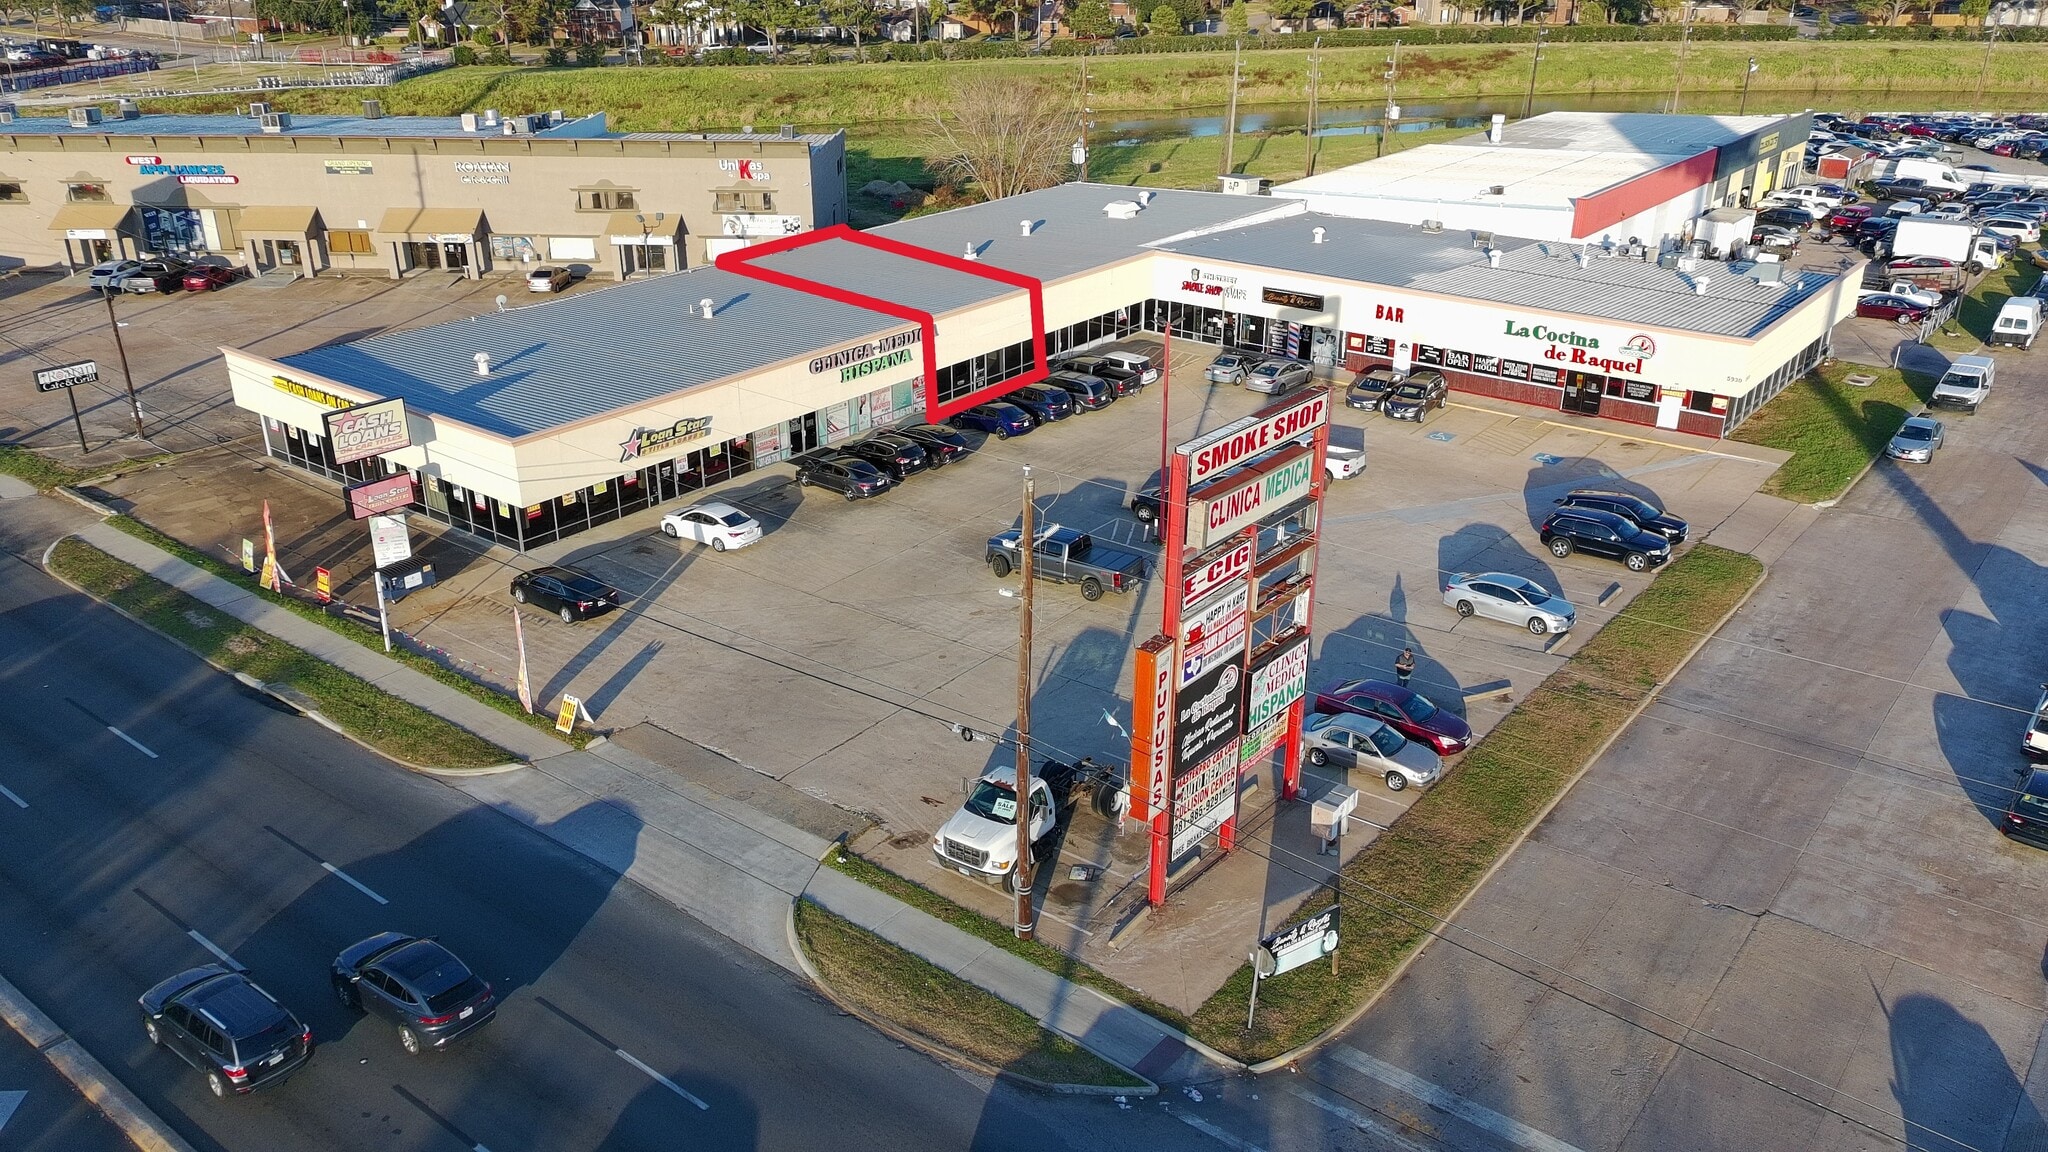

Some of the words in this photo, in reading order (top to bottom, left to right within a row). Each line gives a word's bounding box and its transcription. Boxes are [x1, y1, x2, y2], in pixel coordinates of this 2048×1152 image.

[128, 156, 157, 165] WEST
[140, 165, 226, 175] APPLIANCES
[454, 161, 511, 173] ROATAN
[180, 175, 235, 184] LIQUIDATION
[752, 172, 771, 181] spa
[1205, 284, 1223, 296] SHOP
[1375, 304, 1404, 323] BAR
[1504, 320, 1530, 338] La
[1532, 325, 1600, 349] Cocina
[840, 348, 913, 383] HISPANA
[1447, 352, 1469, 362] BAR
[1447, 358, 1470, 367] OPEN
[1475, 363, 1498, 373] HOUR
[1544, 344, 1567, 361] de
[1569, 347, 1643, 374] Raquel
[74, 373, 97, 384] Grill
[288, 381, 305, 396] CASH
[306, 386, 326, 404] LOANS
[337, 421, 401, 449] LOANS
[341, 410, 394, 434] CASH
[640, 428, 674, 448] Loan
[674, 419, 707, 437] Star
[1197, 423, 1269, 476] SMOKE
[1273, 400, 1323, 440] SHOP
[368, 493, 388, 504] Loan
[388, 486, 409, 497] Star
[1210, 482, 1260, 529] CLINICA
[1264, 458, 1310, 502] MEDICA
[1184, 546, 1249, 598] E-CIG
[1206, 602, 1225, 626] HAPPY
[1226, 600, 1232, 610] H
[1269, 643, 1307, 677] CLINICA
[1265, 659, 1305, 697] MEDICA
[1249, 676, 1304, 727] HISPANA
[1153, 670, 1168, 806] PUPUSAS
[1178, 758, 1211, 788] MASTERPRO
[1212, 749, 1224, 765] CAR
[1224, 740, 1238, 756] CARE
[1175, 786, 1209, 821] COLLISION
[1211, 766, 1236, 795] CENTER
[1182, 774, 1204, 801] AUTO
[997, 802, 1014, 811] SALE
[1173, 843, 1185, 856] FREE
[1186, 830, 1203, 849] BRAKE
